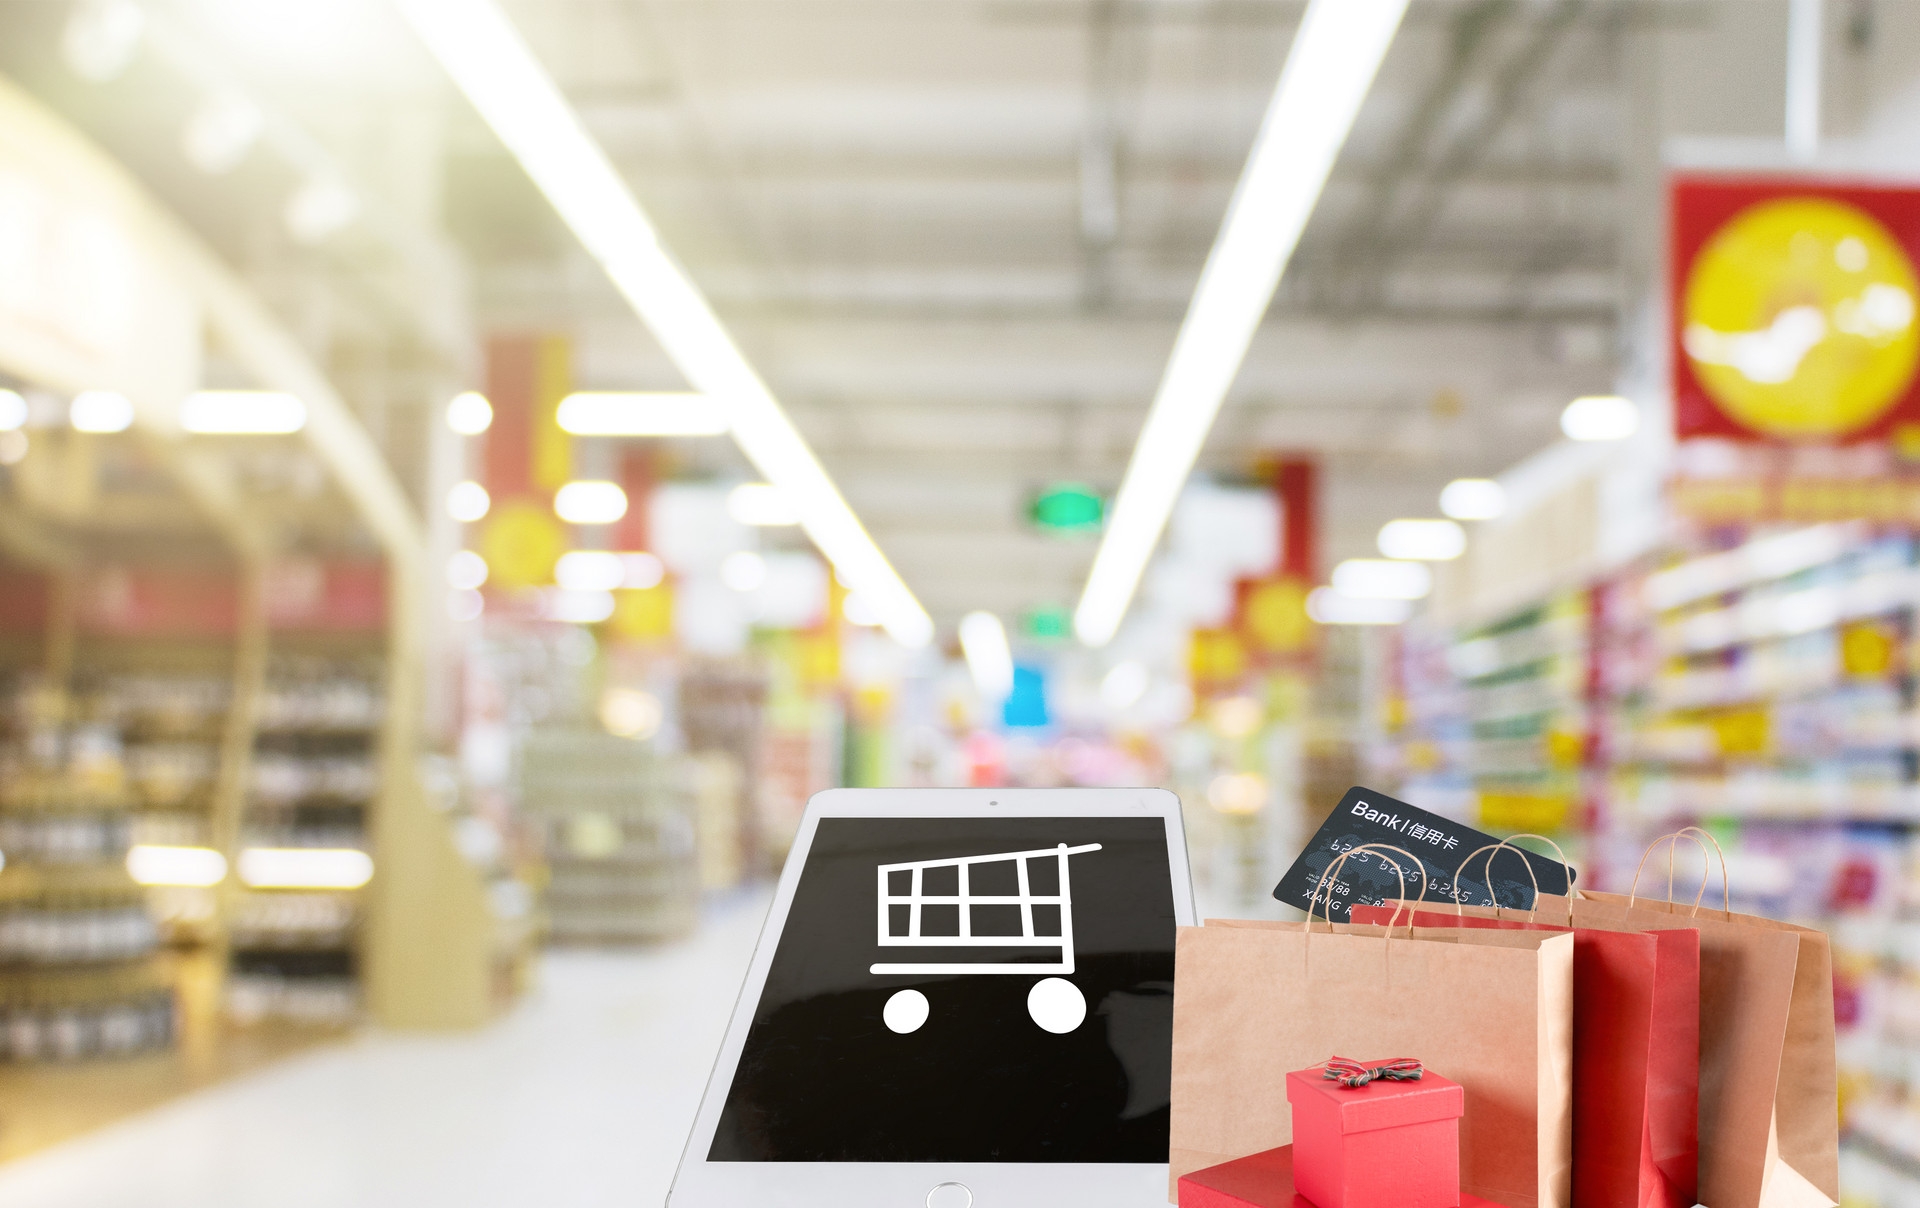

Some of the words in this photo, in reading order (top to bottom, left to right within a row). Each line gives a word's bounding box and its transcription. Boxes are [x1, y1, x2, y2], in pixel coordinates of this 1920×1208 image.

[1351, 800, 1401, 830] Bank
[1407, 822, 1459, 850] 信用卡
